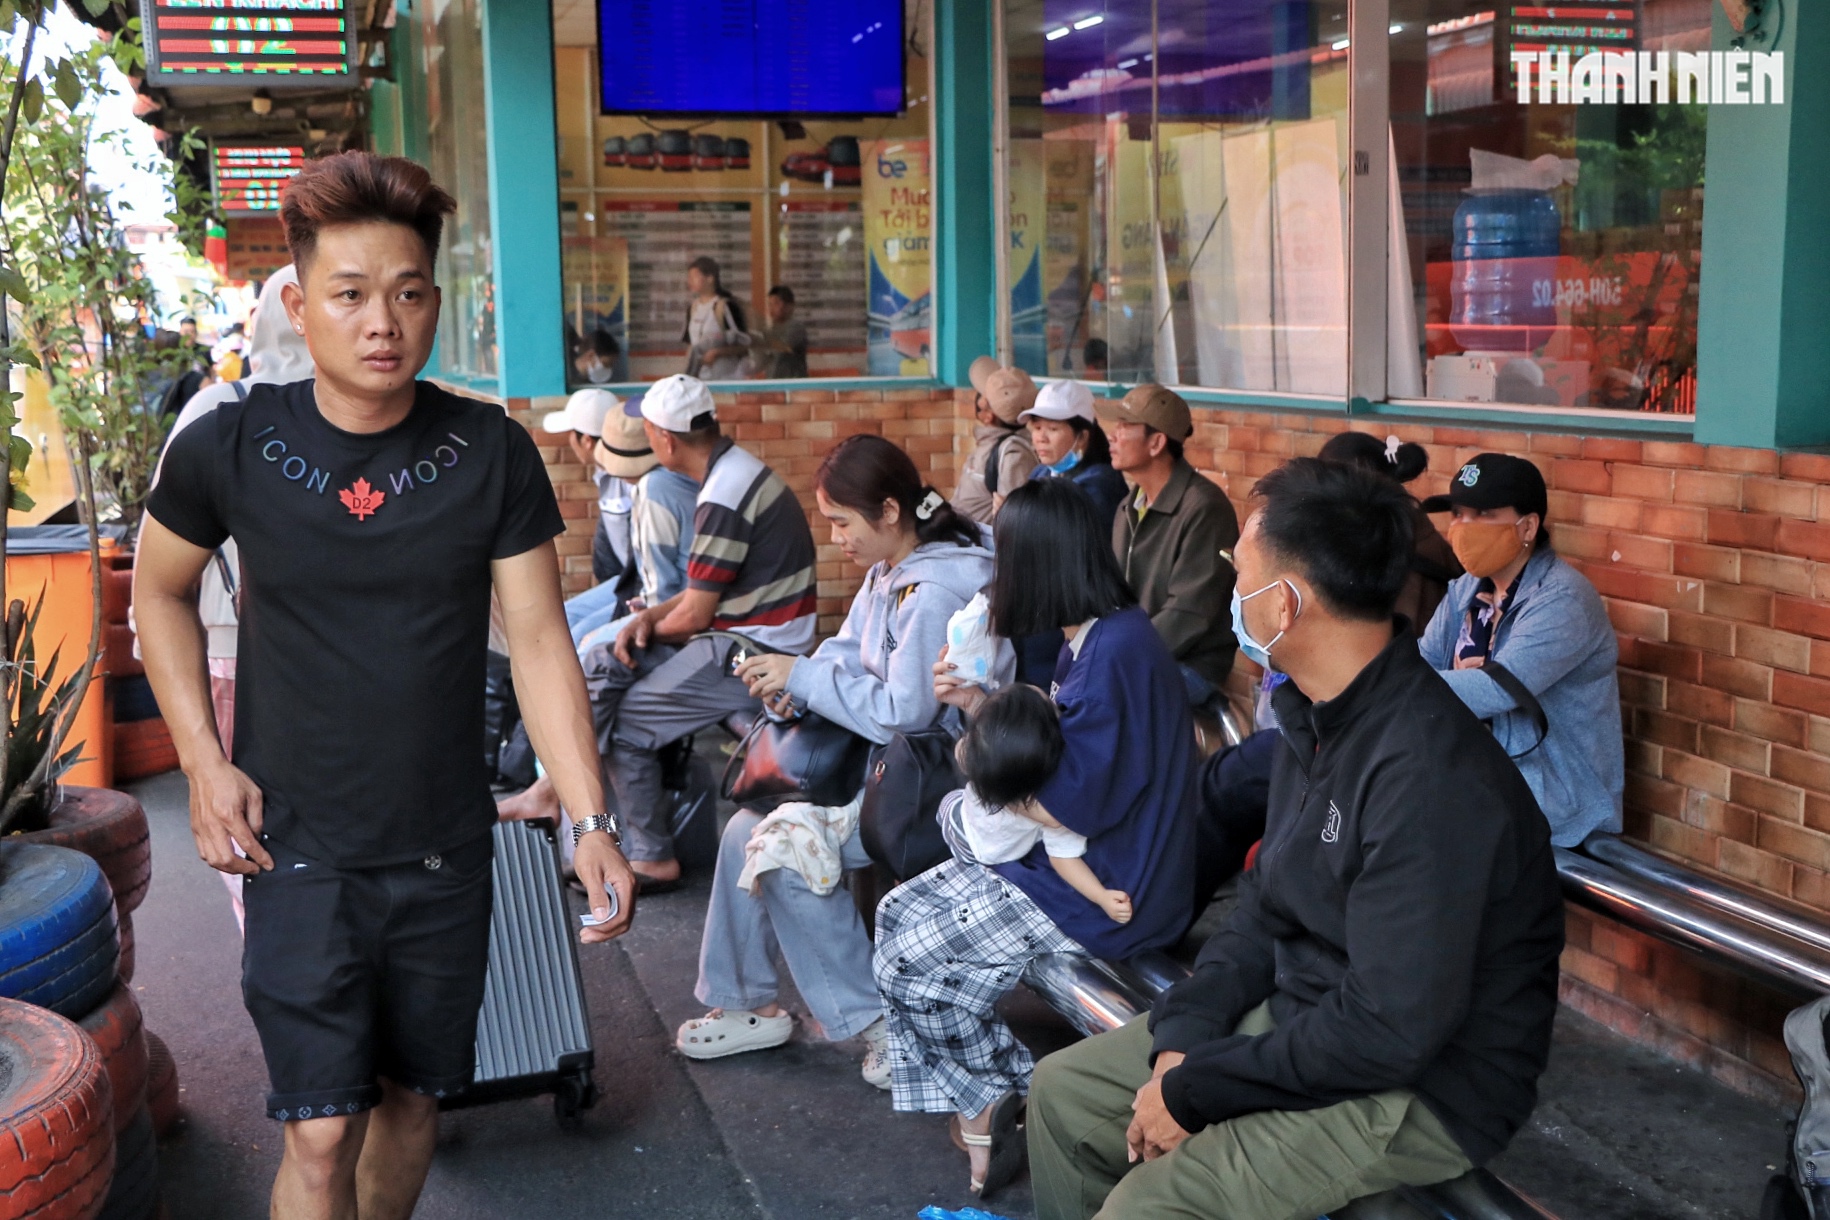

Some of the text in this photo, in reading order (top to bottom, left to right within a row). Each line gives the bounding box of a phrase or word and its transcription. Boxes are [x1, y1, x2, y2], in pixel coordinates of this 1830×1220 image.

[877, 154, 907, 178] be
[253, 425, 331, 494] ICON
[352, 497, 371, 509] D2
